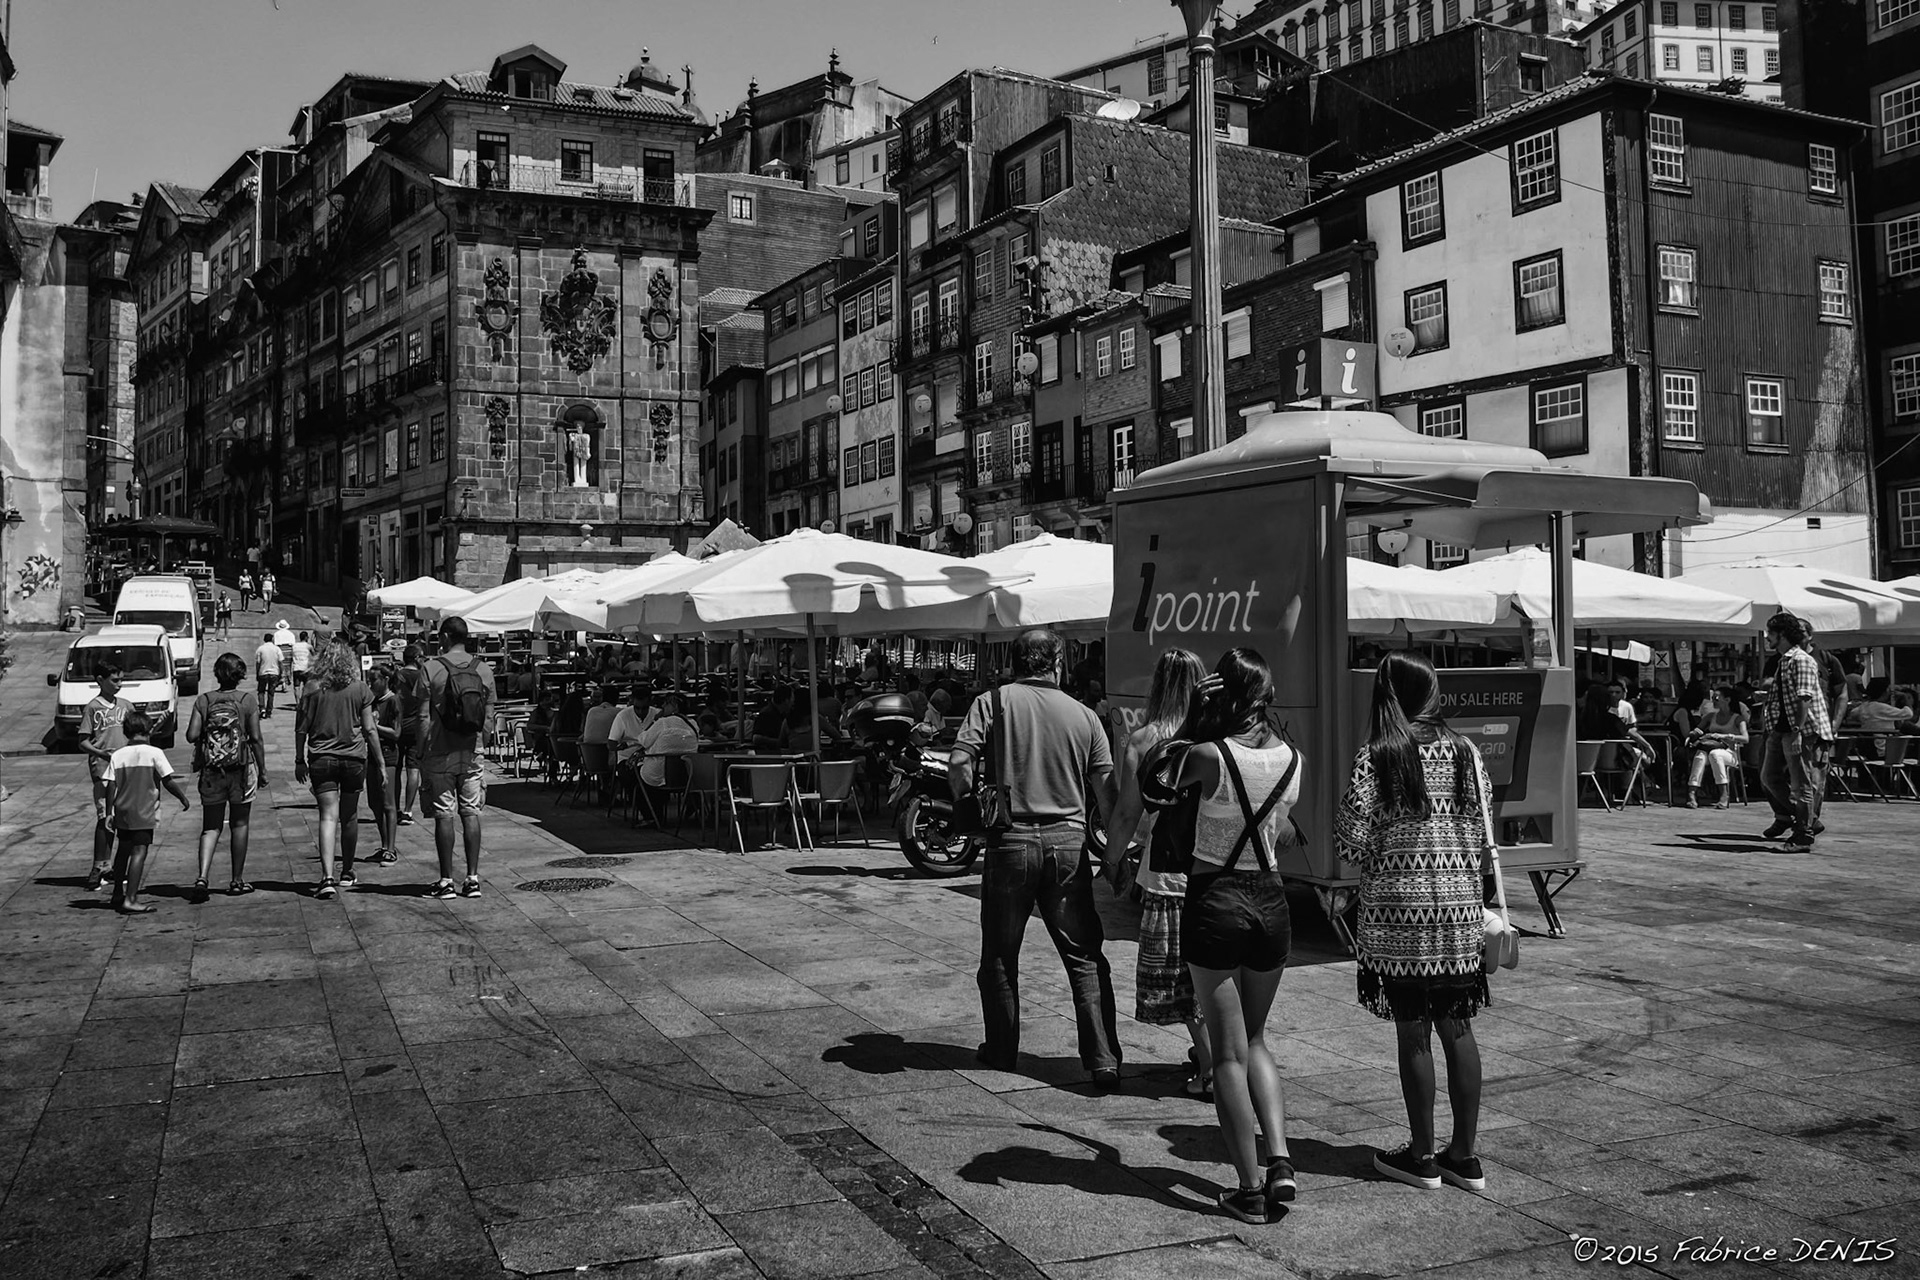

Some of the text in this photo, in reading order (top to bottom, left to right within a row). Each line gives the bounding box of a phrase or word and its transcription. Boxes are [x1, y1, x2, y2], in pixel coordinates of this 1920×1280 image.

[1341, 347, 1358, 395] i
[1460, 692, 1490, 706] SALE
[1492, 691, 1523, 705] HERE
